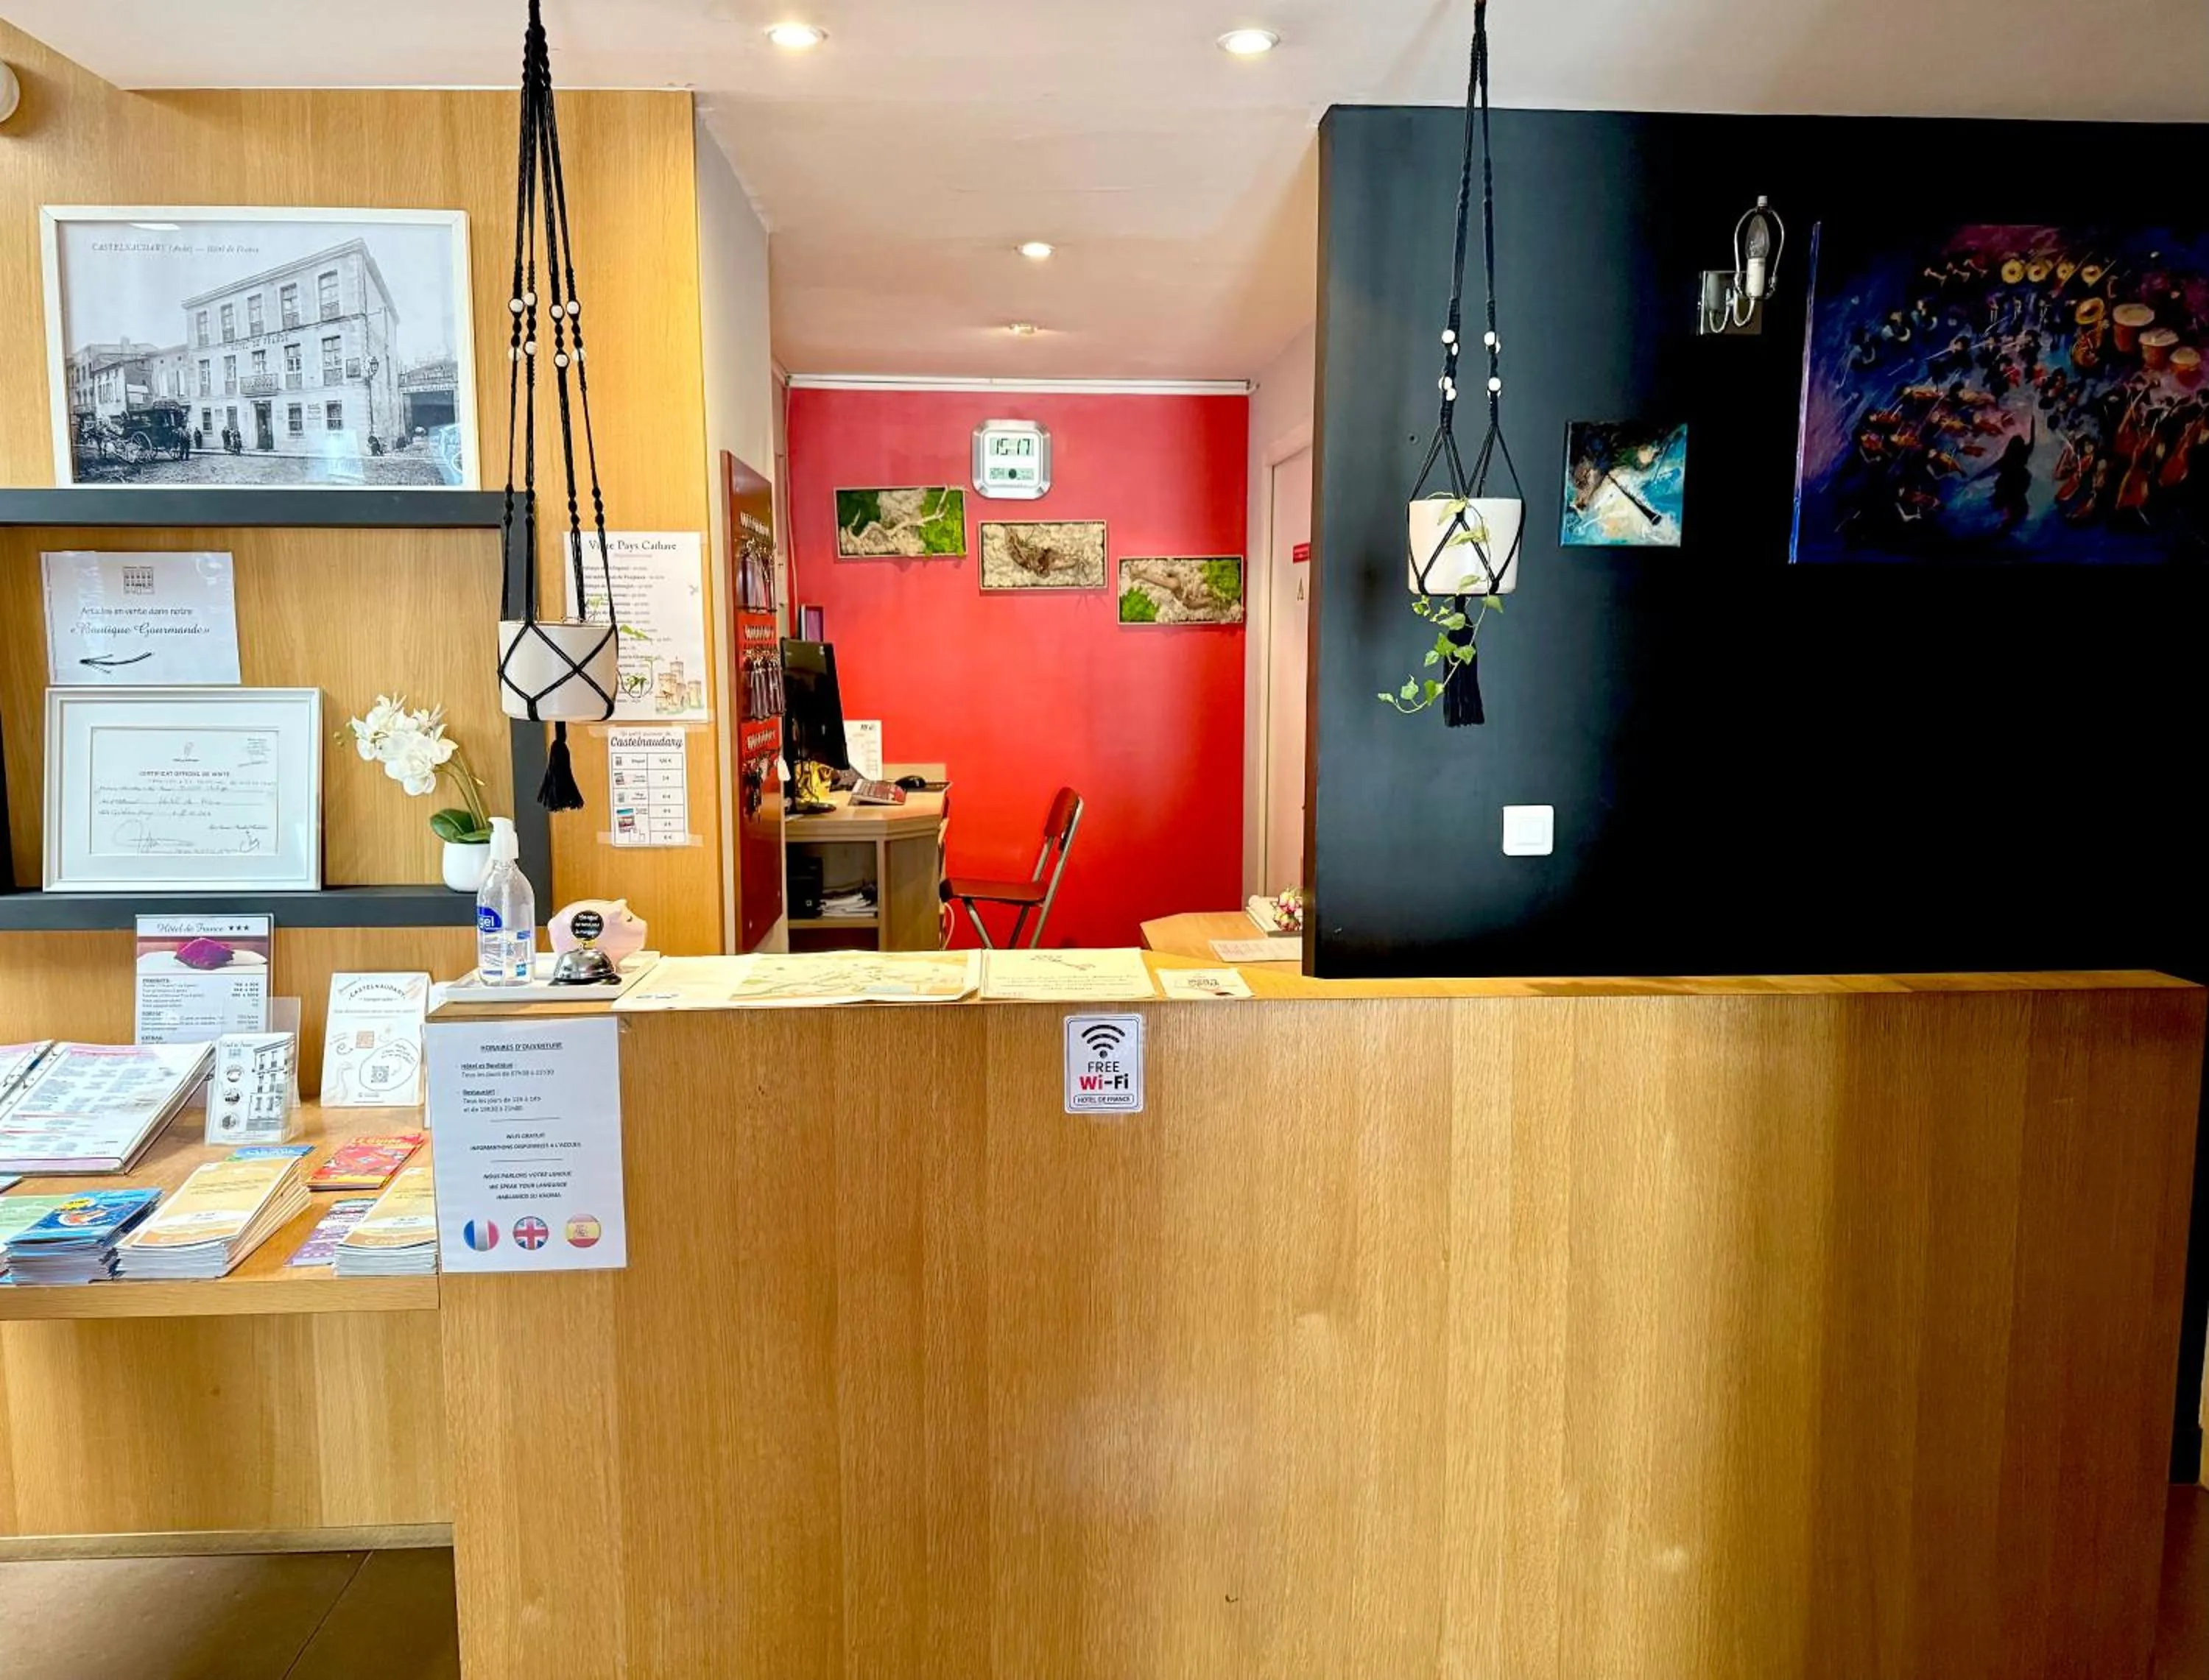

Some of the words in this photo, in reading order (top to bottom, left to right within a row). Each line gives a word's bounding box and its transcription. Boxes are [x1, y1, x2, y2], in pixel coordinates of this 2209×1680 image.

[617, 540, 638, 553] Pays
[641, 540, 677, 550] Cathare
[610, 736, 683, 749] Castelnaudary
[1088, 1061, 1120, 1073] FREE
[1079, 1073, 1129, 1090] Wi-Fi
